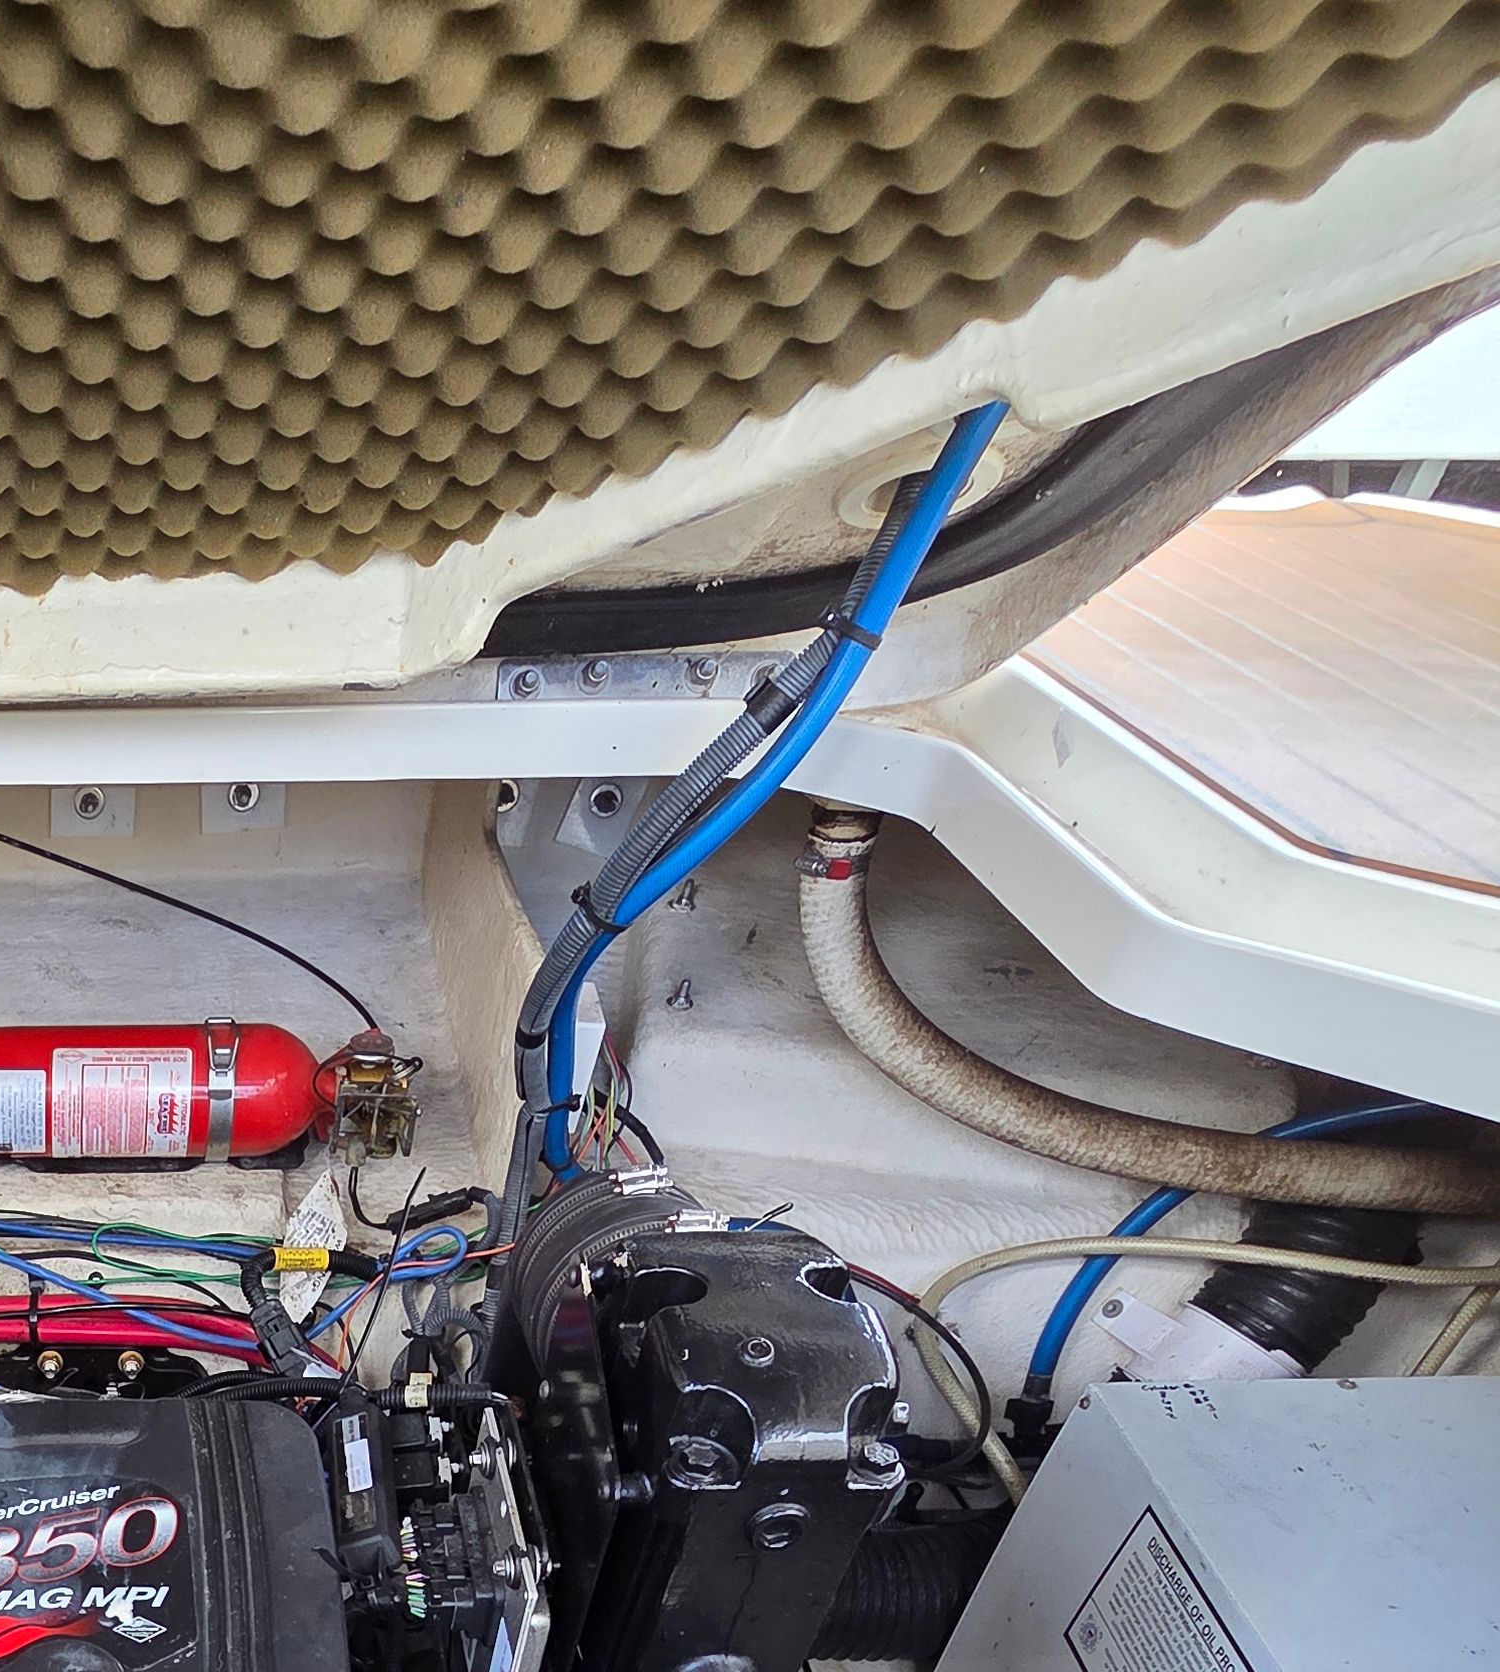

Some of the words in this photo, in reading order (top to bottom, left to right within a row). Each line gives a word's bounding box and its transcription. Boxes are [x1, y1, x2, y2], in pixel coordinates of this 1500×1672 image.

[82, 1586, 169, 1608] MPI
[1148, 1534, 1193, 1607] DISCHARGE
[1189, 1602, 1204, 1627] OF
[1200, 1621, 1218, 1649] OIL
